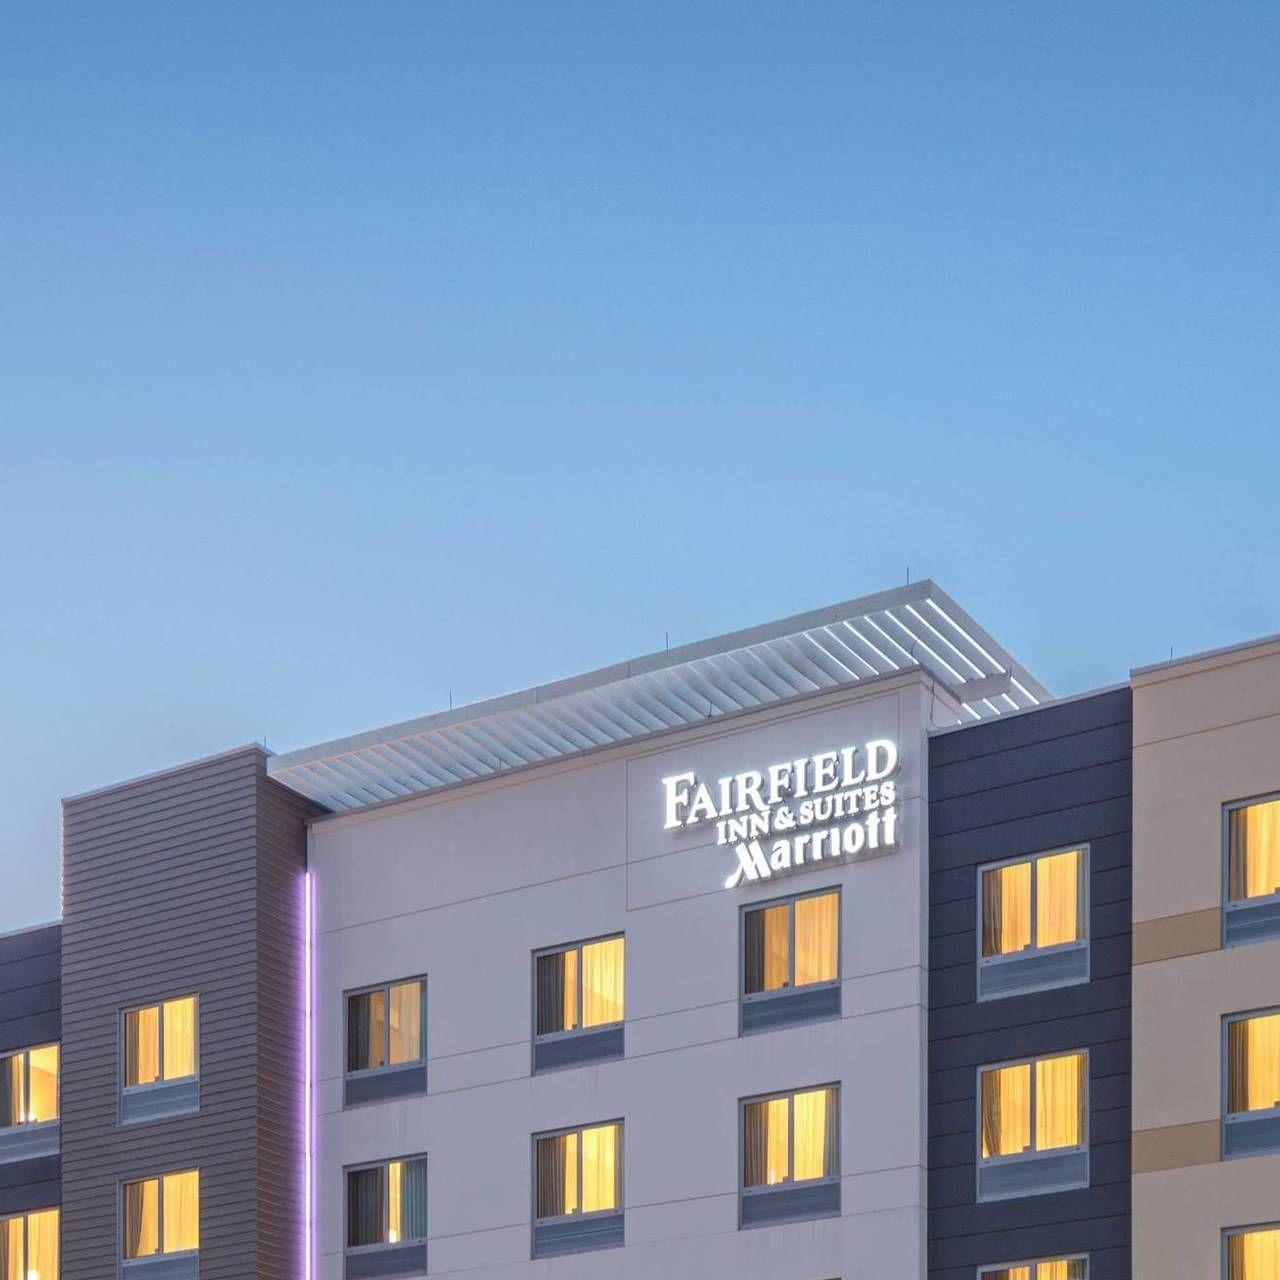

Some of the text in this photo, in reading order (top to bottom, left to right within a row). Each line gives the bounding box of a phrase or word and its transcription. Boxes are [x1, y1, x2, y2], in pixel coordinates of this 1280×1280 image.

[662, 739, 898, 829] FAIRFIELD
[716, 781, 896, 845] INN & SUITES
[724, 807, 897, 889] Marriott
